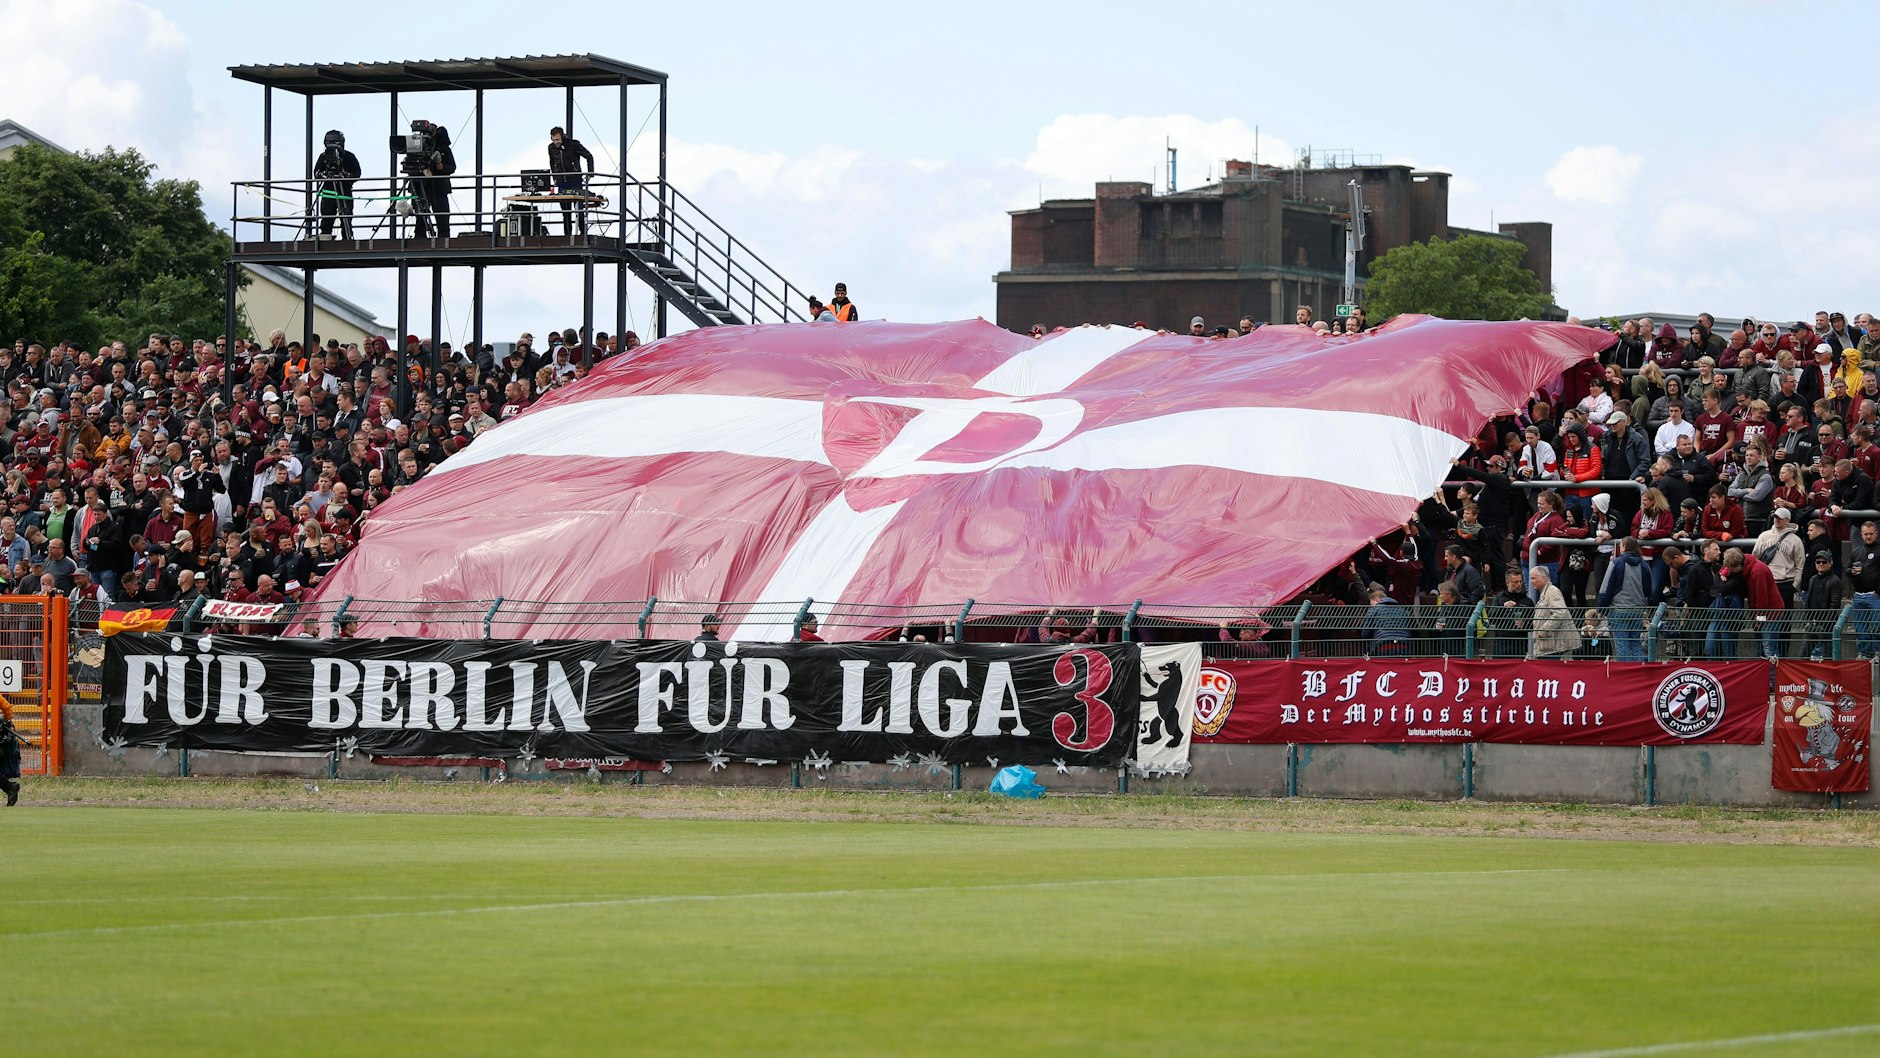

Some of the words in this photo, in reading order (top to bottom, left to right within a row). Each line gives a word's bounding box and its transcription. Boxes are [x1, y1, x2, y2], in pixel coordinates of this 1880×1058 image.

[1744, 425, 1765, 435] BFC
[2, 666, 13, 686] 9
[1416, 669, 1587, 702] Dynamo
[1659, 678, 1681, 709] BERLINER
[1680, 674, 1713, 691] FUSSBALL
[1708, 689, 1718, 708] CLUB
[1779, 683, 1806, 694] mythos
[122, 636, 270, 726] FÜR
[308, 658, 598, 733] BERLIN
[634, 642, 797, 734] FÜR
[837, 659, 1031, 738] LIGA
[1051, 649, 1115, 753] 3
[1279, 703, 1332, 725] Der
[1342, 703, 1451, 726] Mythos
[1462, 704, 1550, 724] stirbt
[1562, 706, 1604, 726] nie
[1661, 711, 1670, 719] 19
[1784, 715, 1794, 723] on
[1838, 714, 1856, 723] tour
[1669, 720, 1707, 732] DYNAMO
[1407, 728, 1473, 737] www.mythosbfc.de
